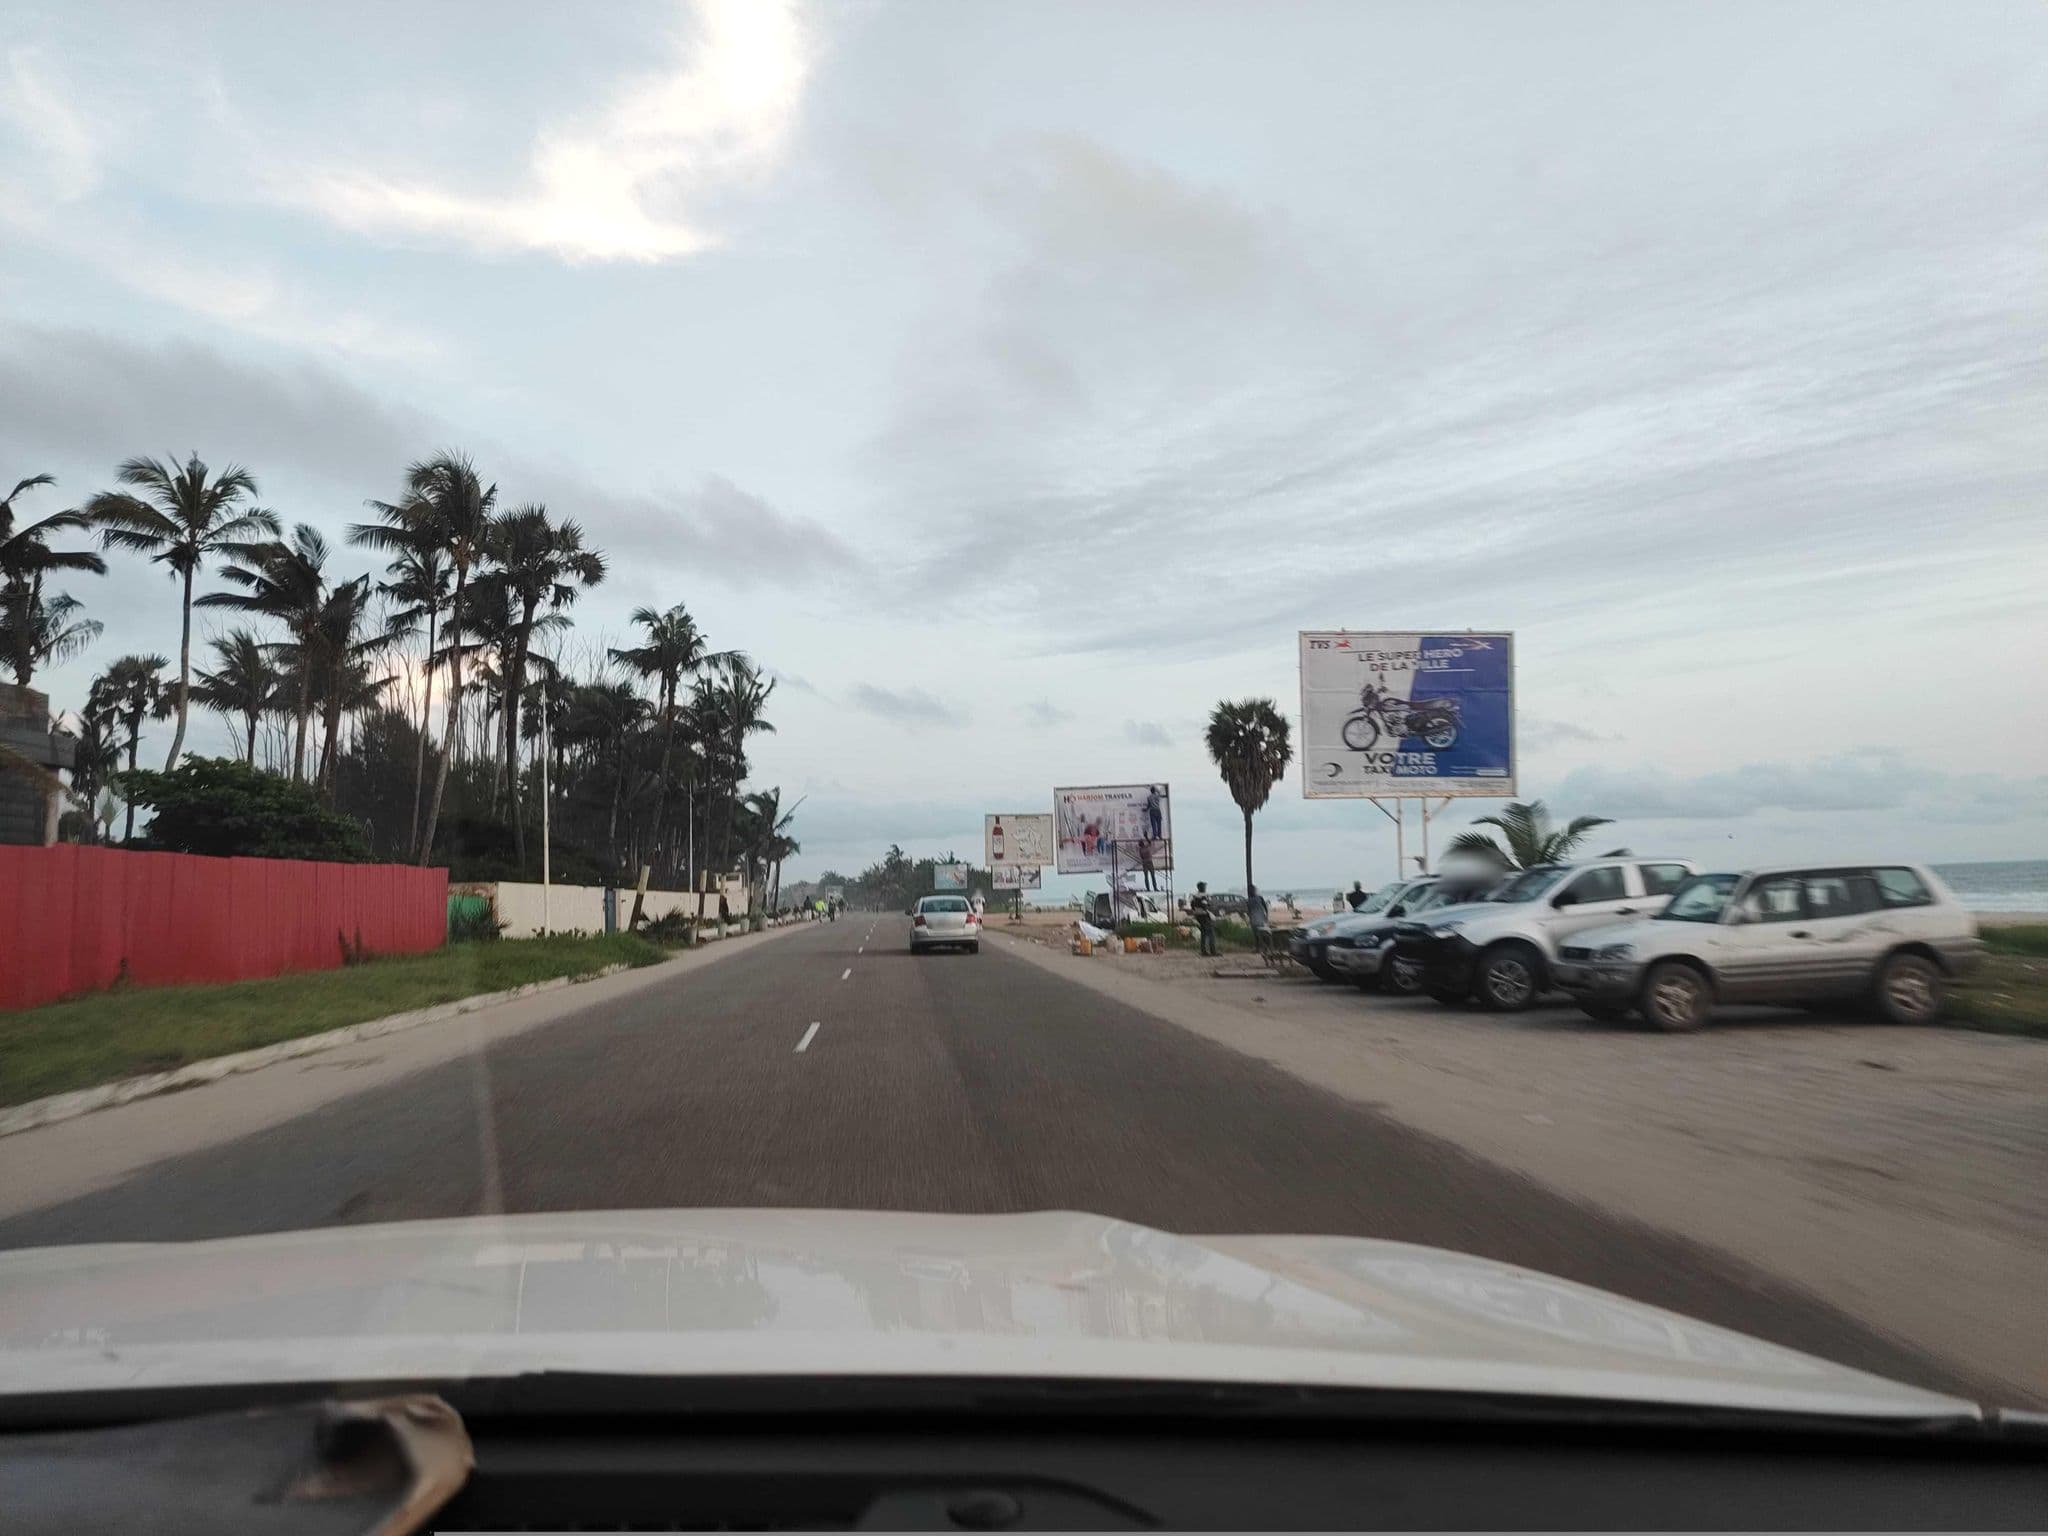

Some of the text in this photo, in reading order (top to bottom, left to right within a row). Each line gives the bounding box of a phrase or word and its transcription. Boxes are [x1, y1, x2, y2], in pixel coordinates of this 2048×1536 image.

[1309, 640, 1331, 649] TVS
[1357, 648, 1464, 662] LE SUPER HERO
[1369, 662, 1389, 672] DE
[1392, 661, 1409, 671] LA
[1364, 752, 1437, 765] VOTRE
[1395, 765, 1438, 775] MOTO
